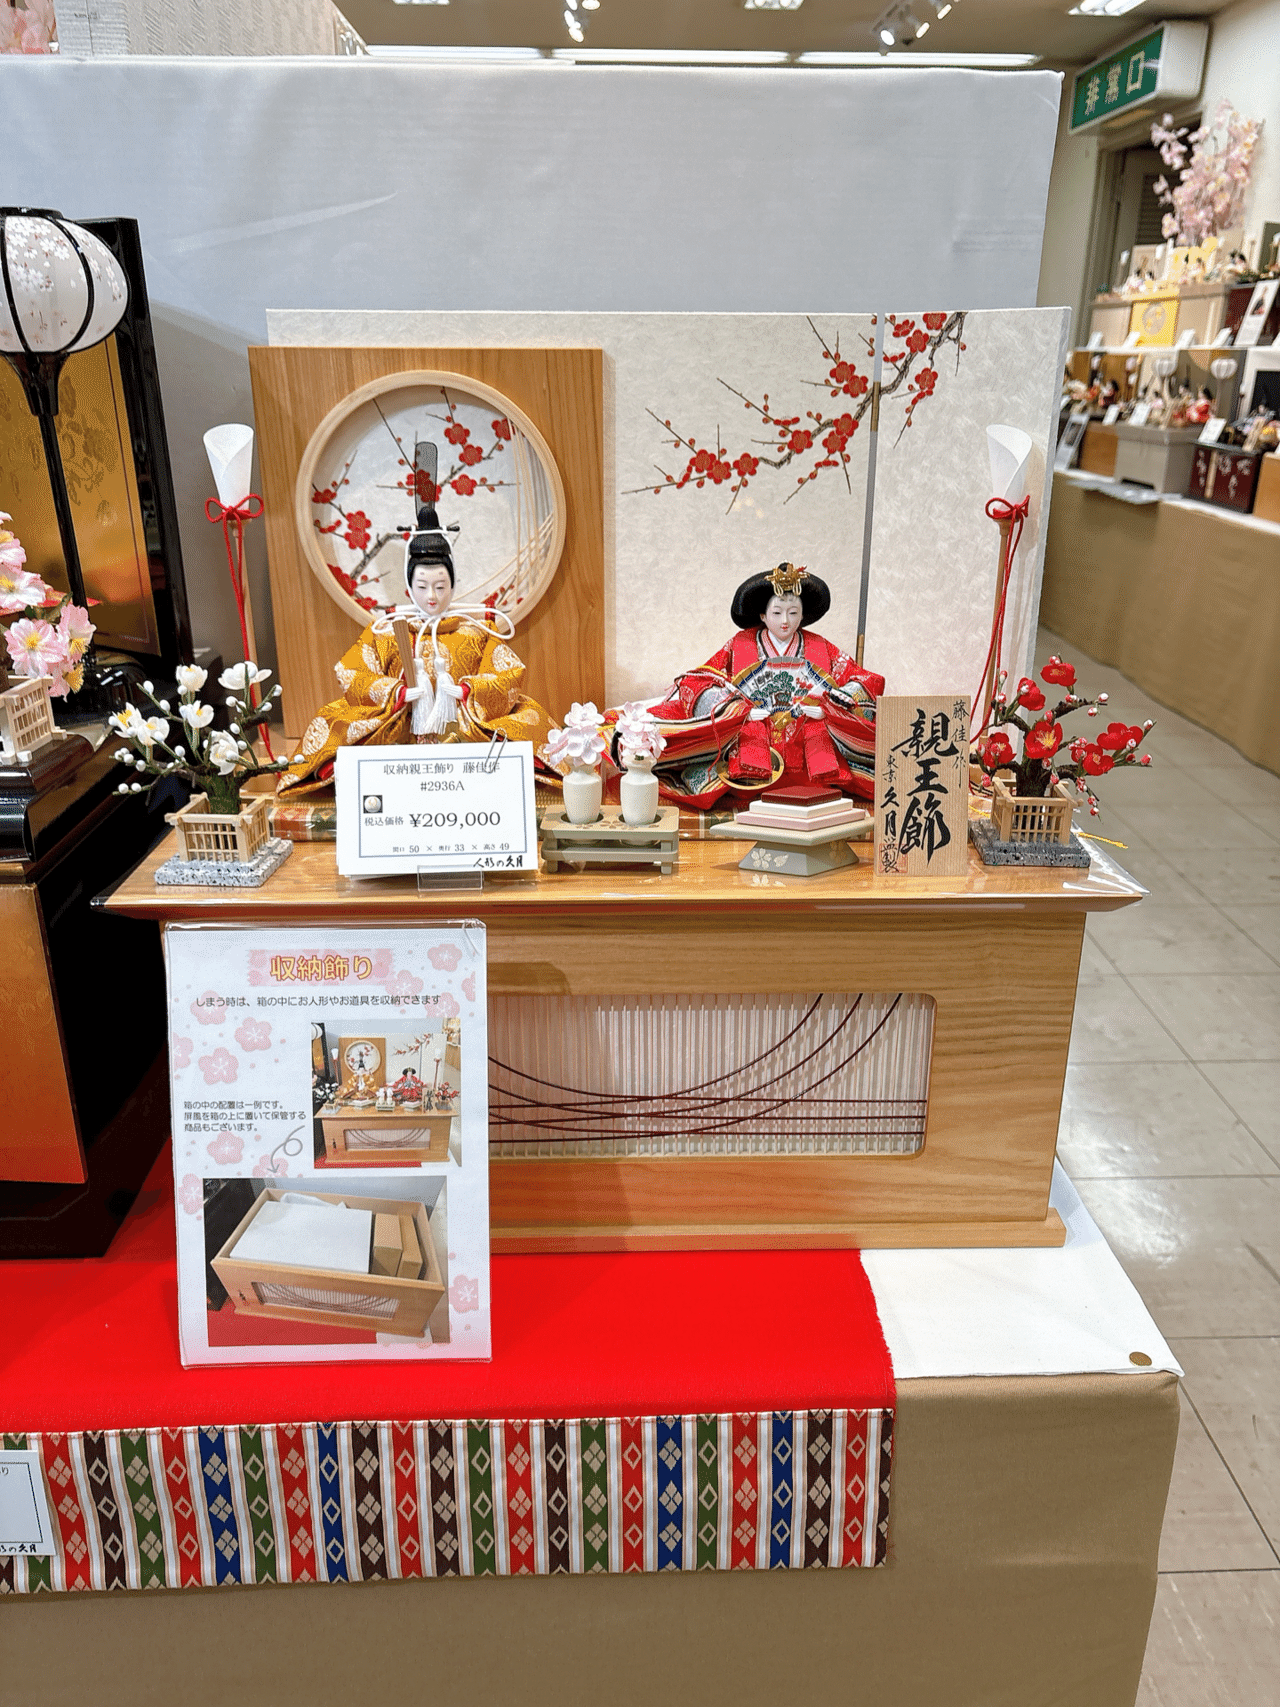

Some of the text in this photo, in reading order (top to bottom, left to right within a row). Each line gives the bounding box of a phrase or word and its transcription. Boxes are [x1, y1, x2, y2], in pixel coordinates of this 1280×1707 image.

[952, 699, 970, 789] 藤佳作
[383, 762, 454, 775] 収納親王飾り
[420, 780, 465, 792] #2936A
[890, 708, 960, 868] 親王飾
[364, 811, 501, 829] 税込価格 ¥209,000
[409, 845, 420, 853] 50
[454, 844, 465, 852] 33
[499, 843, 510, 851] 49
[473, 855, 523, 868] 人形の久月
[270, 954, 373, 982] 収納飾り
